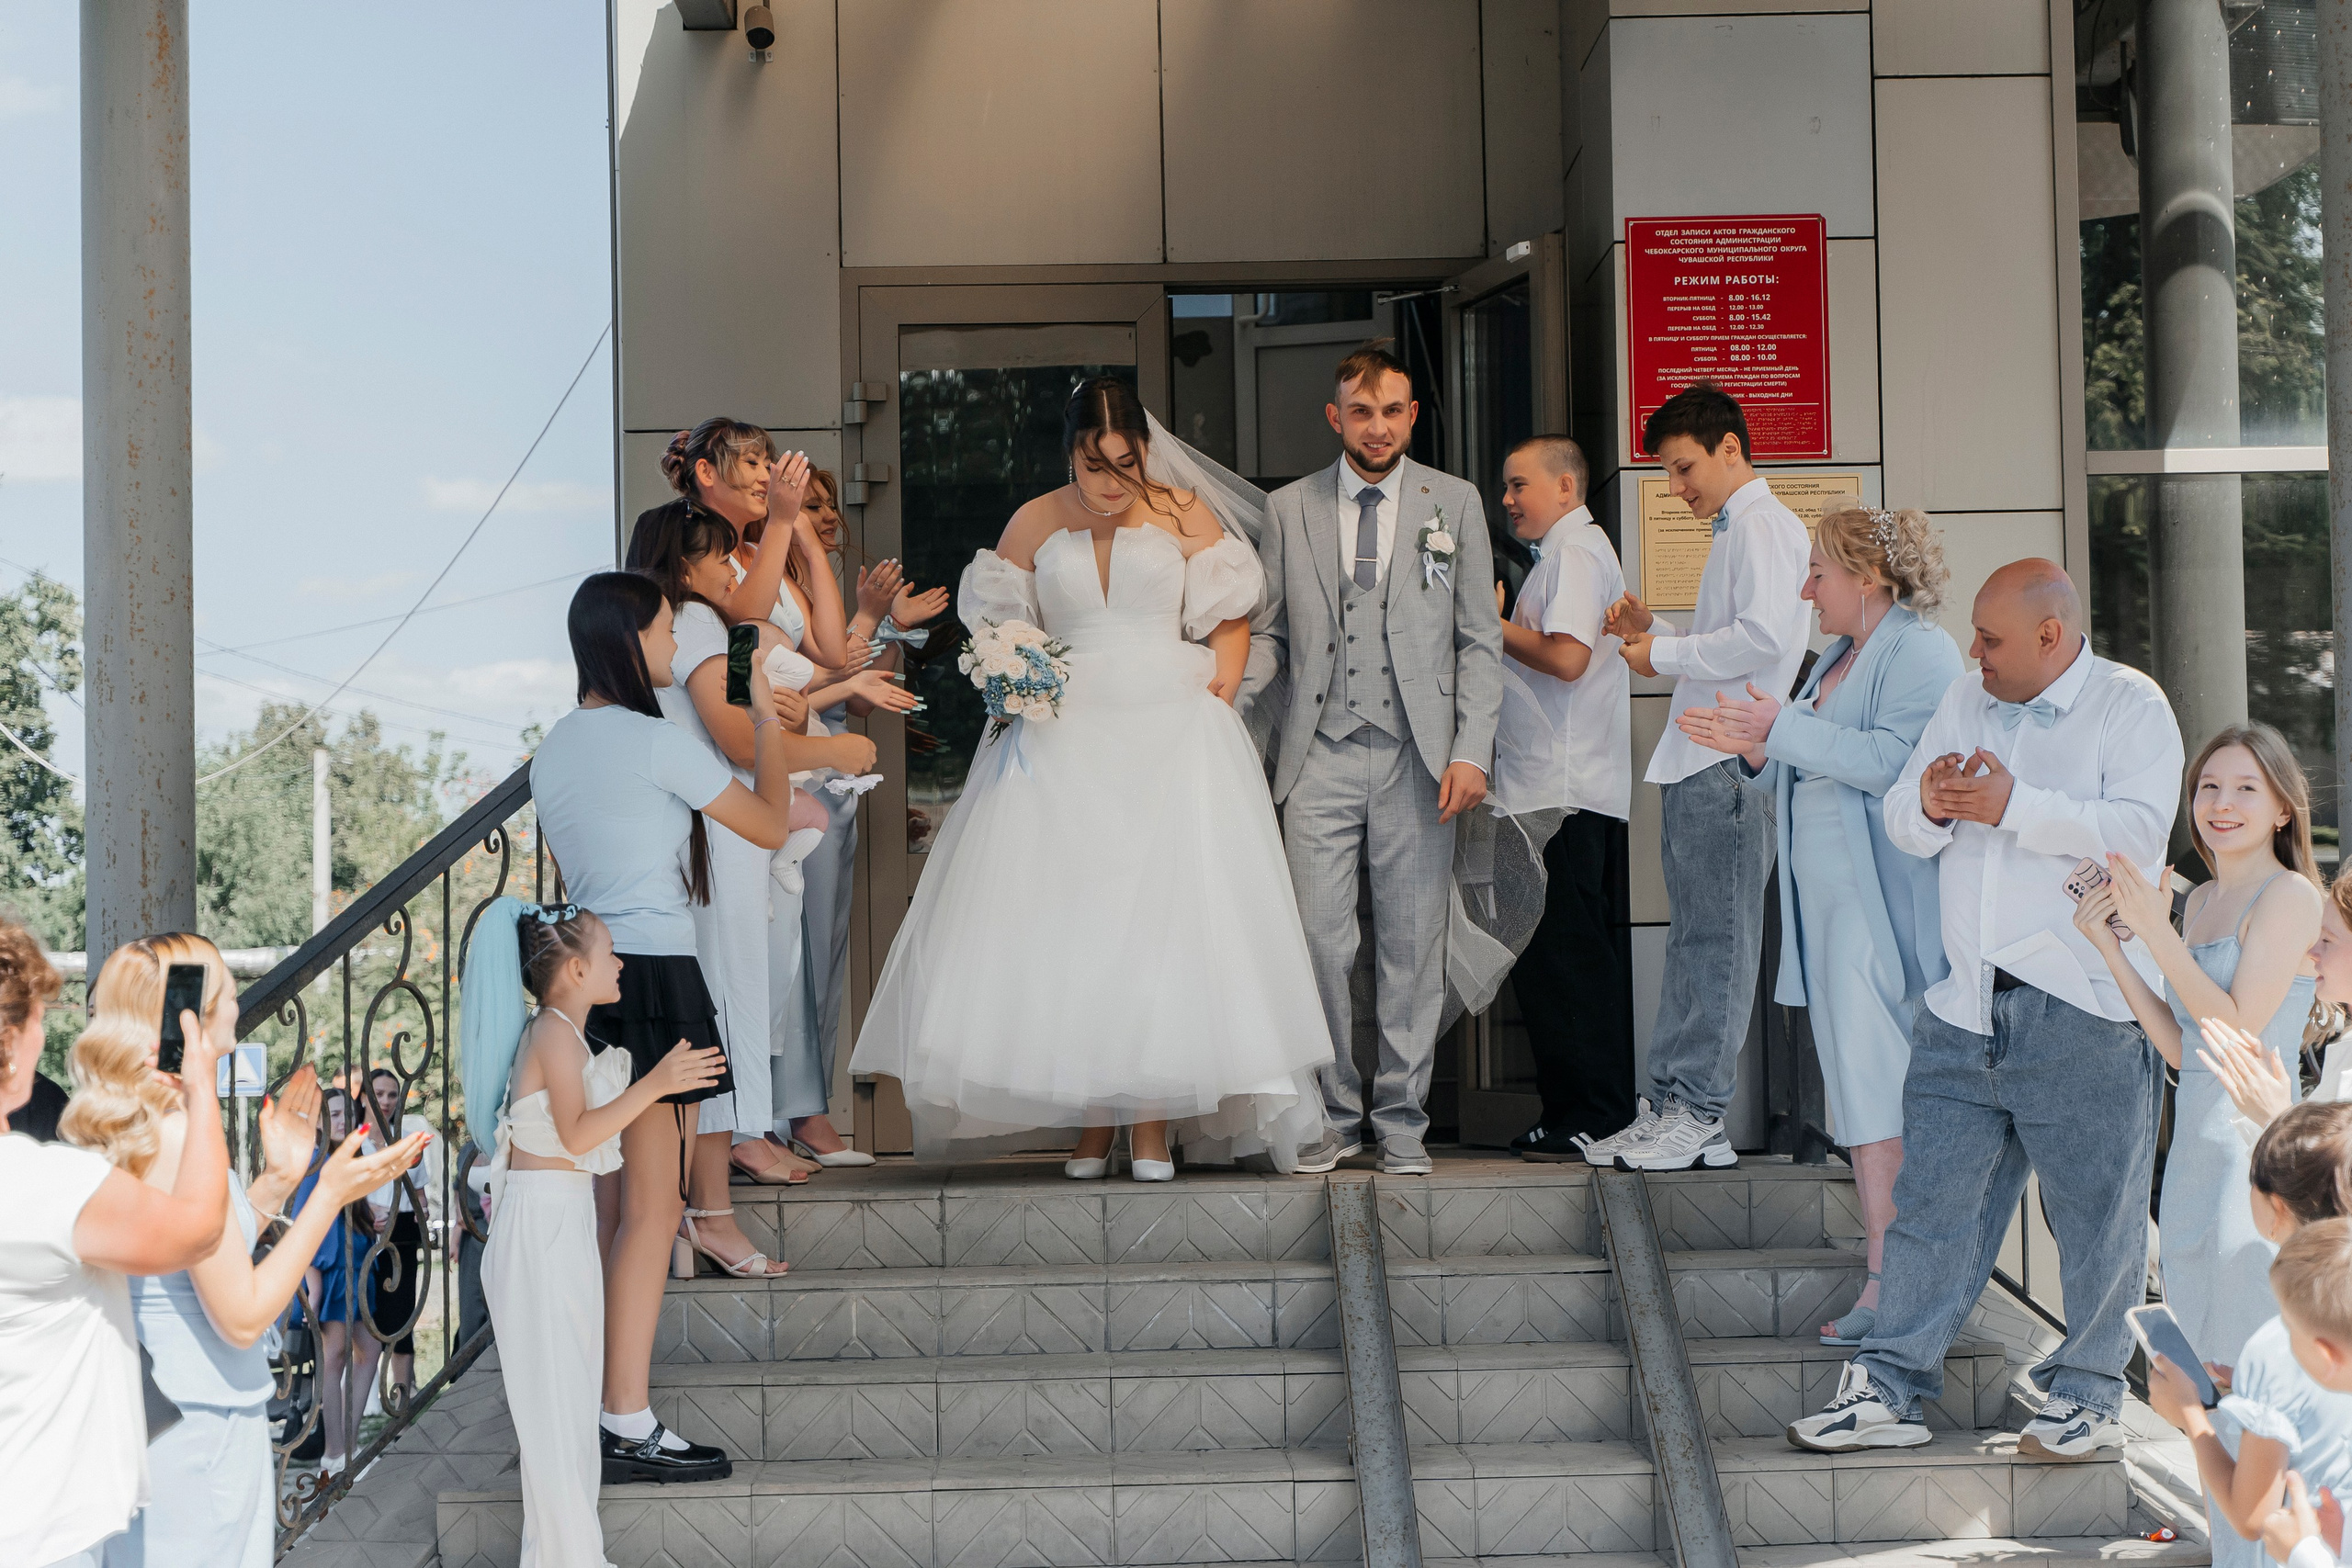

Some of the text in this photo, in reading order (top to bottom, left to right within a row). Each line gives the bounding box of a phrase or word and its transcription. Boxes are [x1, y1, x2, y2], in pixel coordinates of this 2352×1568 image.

[1739, 227, 1795, 235] ГРАЖДАНСКОГО
[1715, 237, 1781, 245] АДМИНИСТРАЦИИ
[1679, 254, 1724, 264] ЧУВАШСКОЙ
[1674, 275, 1780, 286] РЕЖИМ РАБОТЫ:
